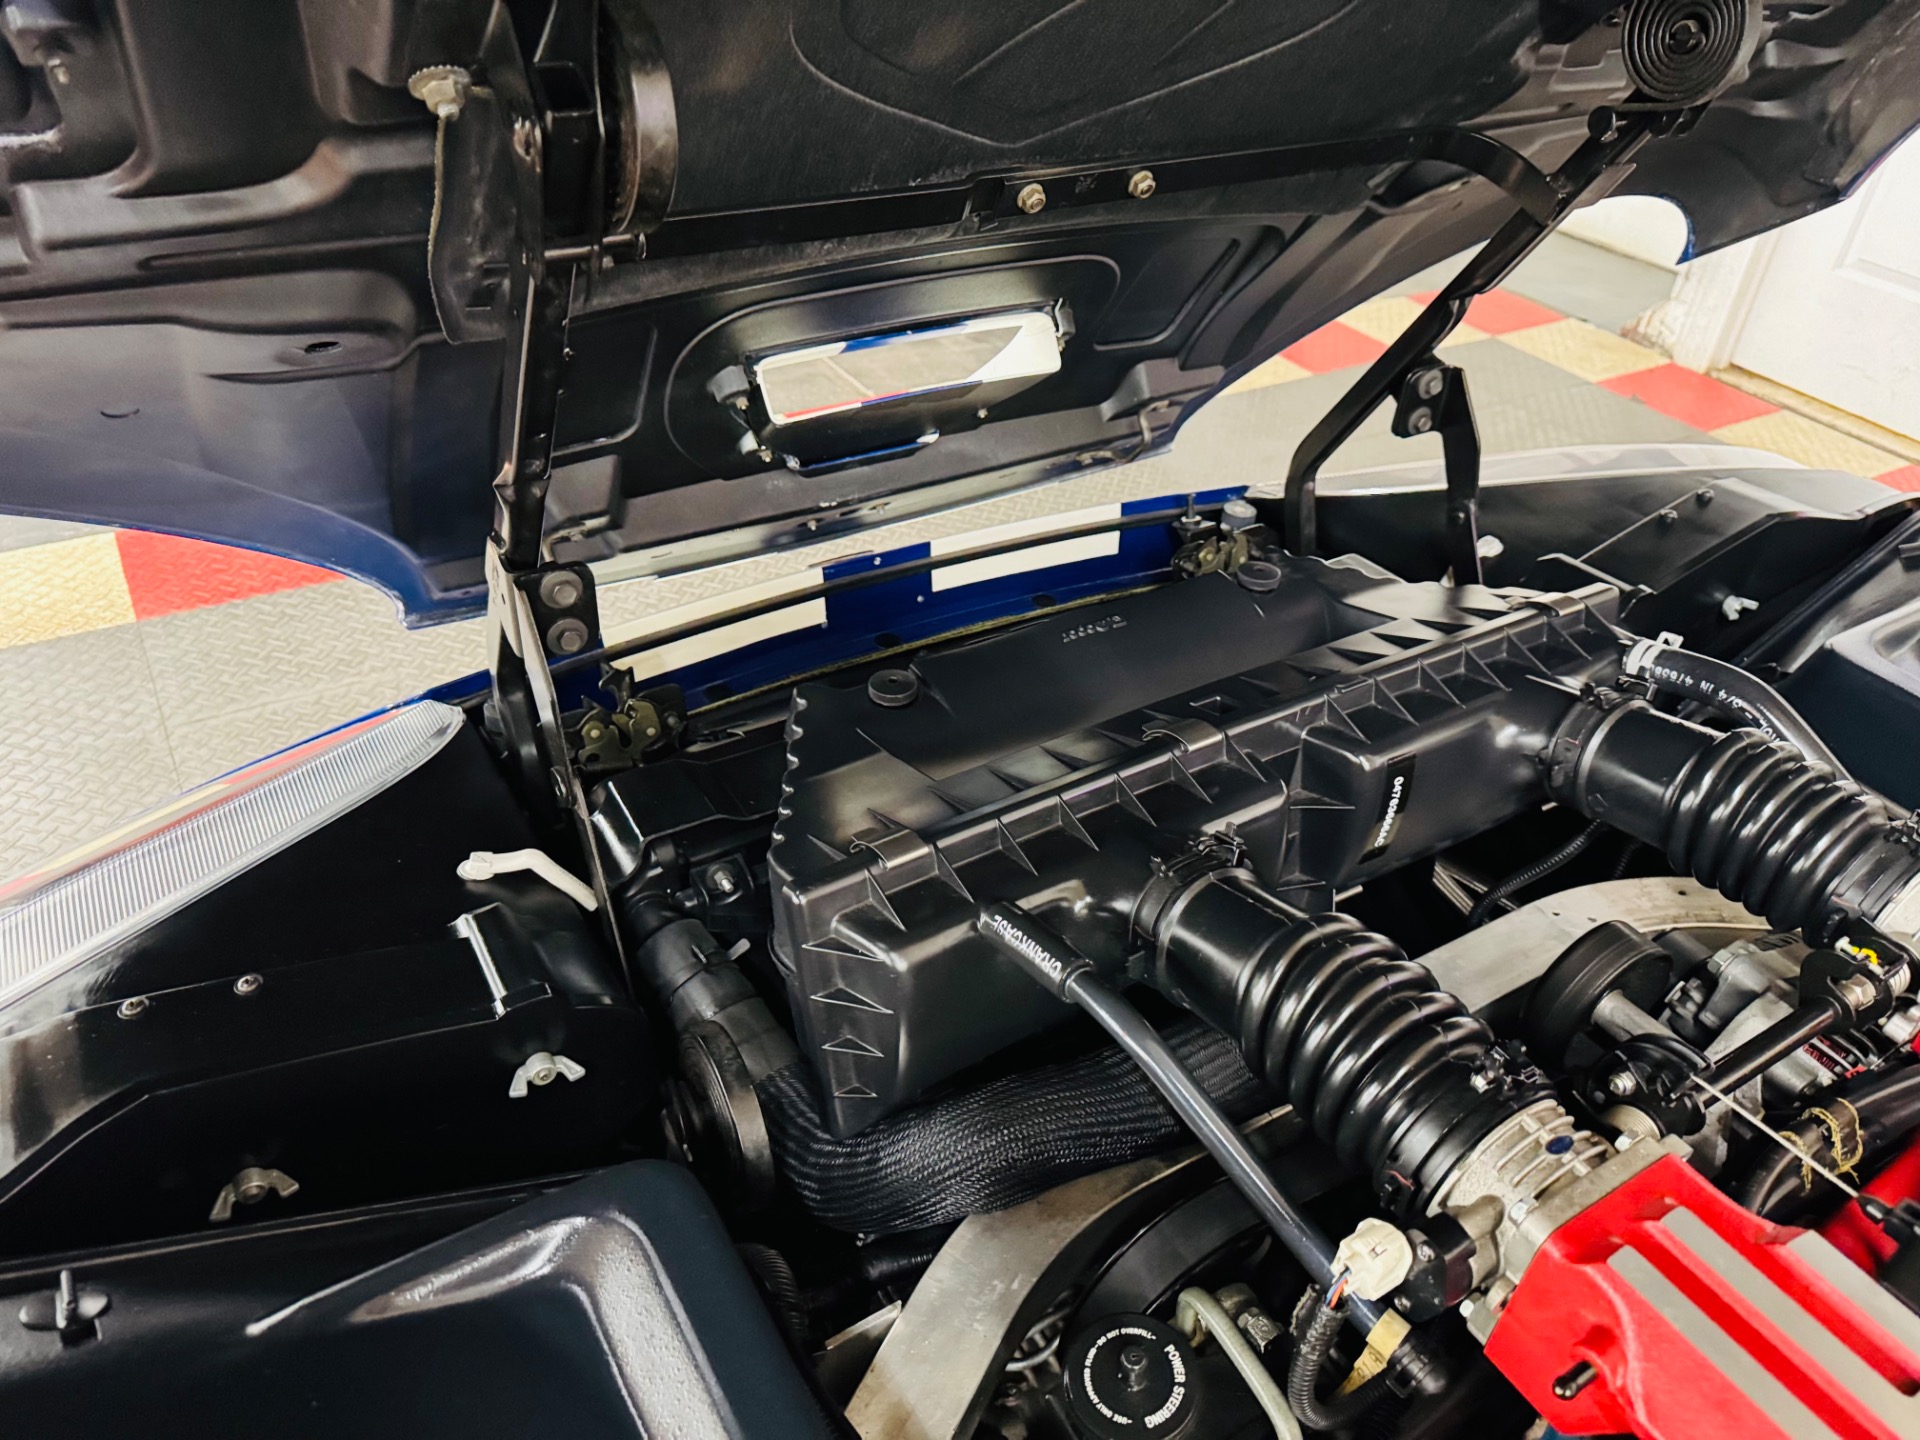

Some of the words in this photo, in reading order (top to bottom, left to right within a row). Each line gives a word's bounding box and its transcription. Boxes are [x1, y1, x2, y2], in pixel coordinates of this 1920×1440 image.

[1699, 679, 1715, 695] IN
[993, 914, 1063, 978] CRANKCASE
[1105, 1328, 1120, 1340] NOT
[1163, 1343, 1186, 1384] POWER
[1083, 1366, 1100, 1405] APPROVED
[1095, 1402, 1113, 1419] ONLY
[1144, 1384, 1186, 1429] STEERING
